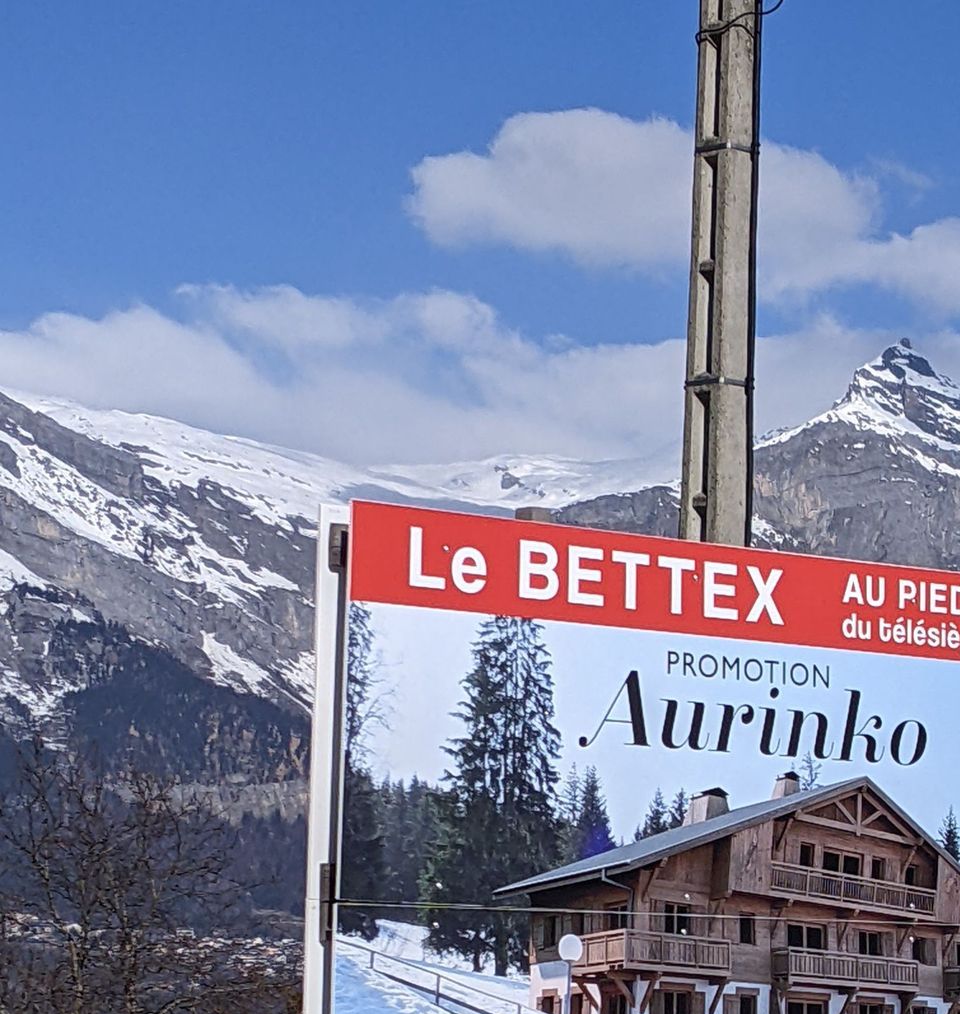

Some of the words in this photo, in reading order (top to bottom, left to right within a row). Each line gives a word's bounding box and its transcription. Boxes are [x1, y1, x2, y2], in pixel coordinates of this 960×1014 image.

[407, 526, 488, 594] Le
[517, 538, 785, 626] BETTEX
[842, 573, 886, 607] AU
[842, 612, 872, 640] du
[666, 651, 830, 689] PROMOTION
[578, 669, 928, 766] Aurinko
